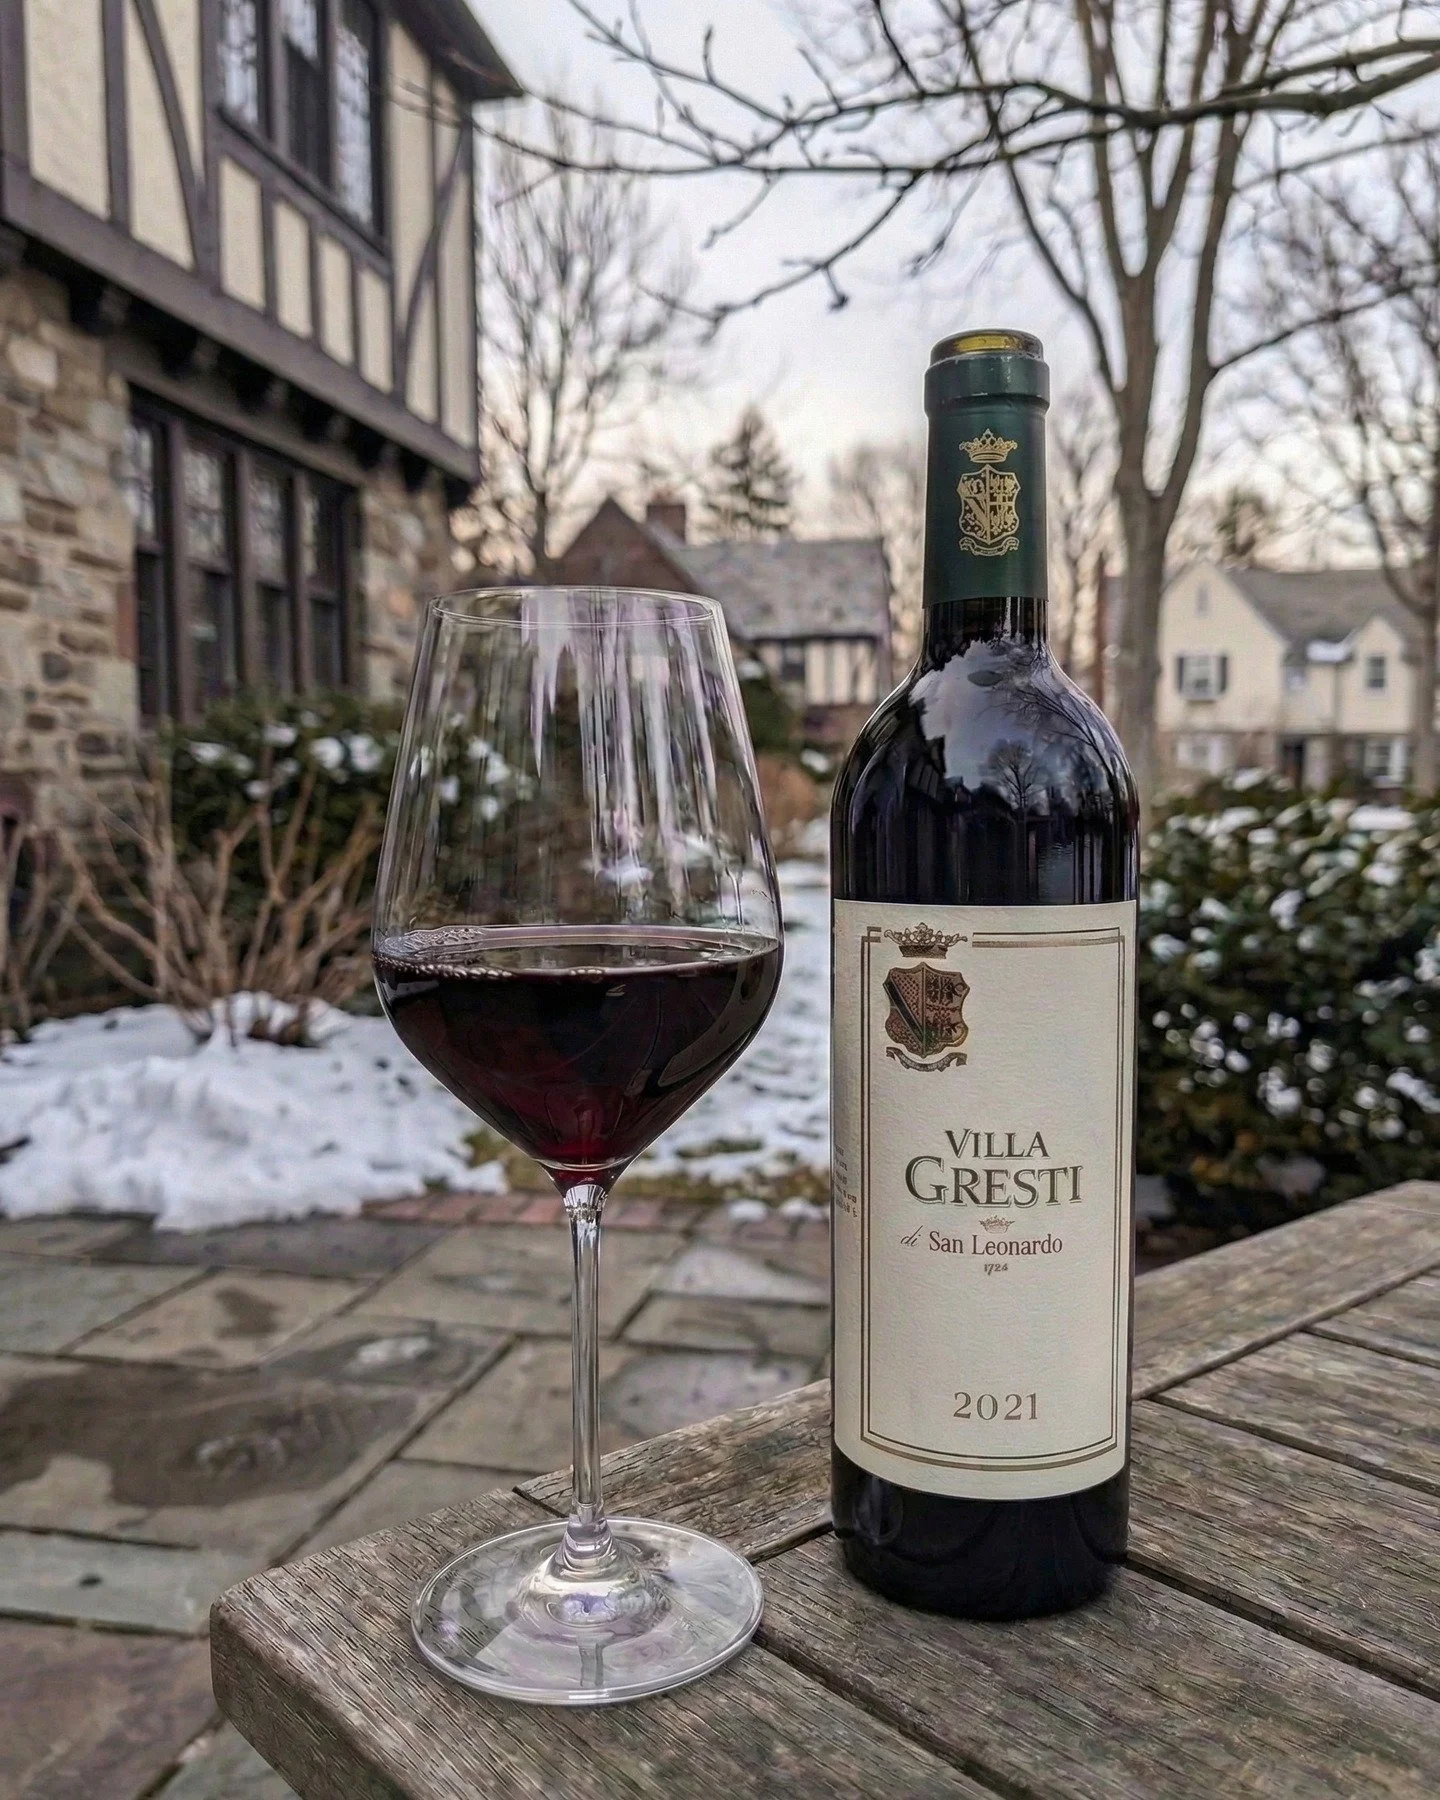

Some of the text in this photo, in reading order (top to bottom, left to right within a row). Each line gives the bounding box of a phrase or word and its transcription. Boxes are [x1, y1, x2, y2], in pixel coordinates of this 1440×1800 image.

[944, 1127, 1050, 1160] VILLA
[905, 1154, 1083, 1208] GRESTI
[900, 1225, 1063, 1256] di San Leonardo
[953, 1391, 1038, 1421] 2021
